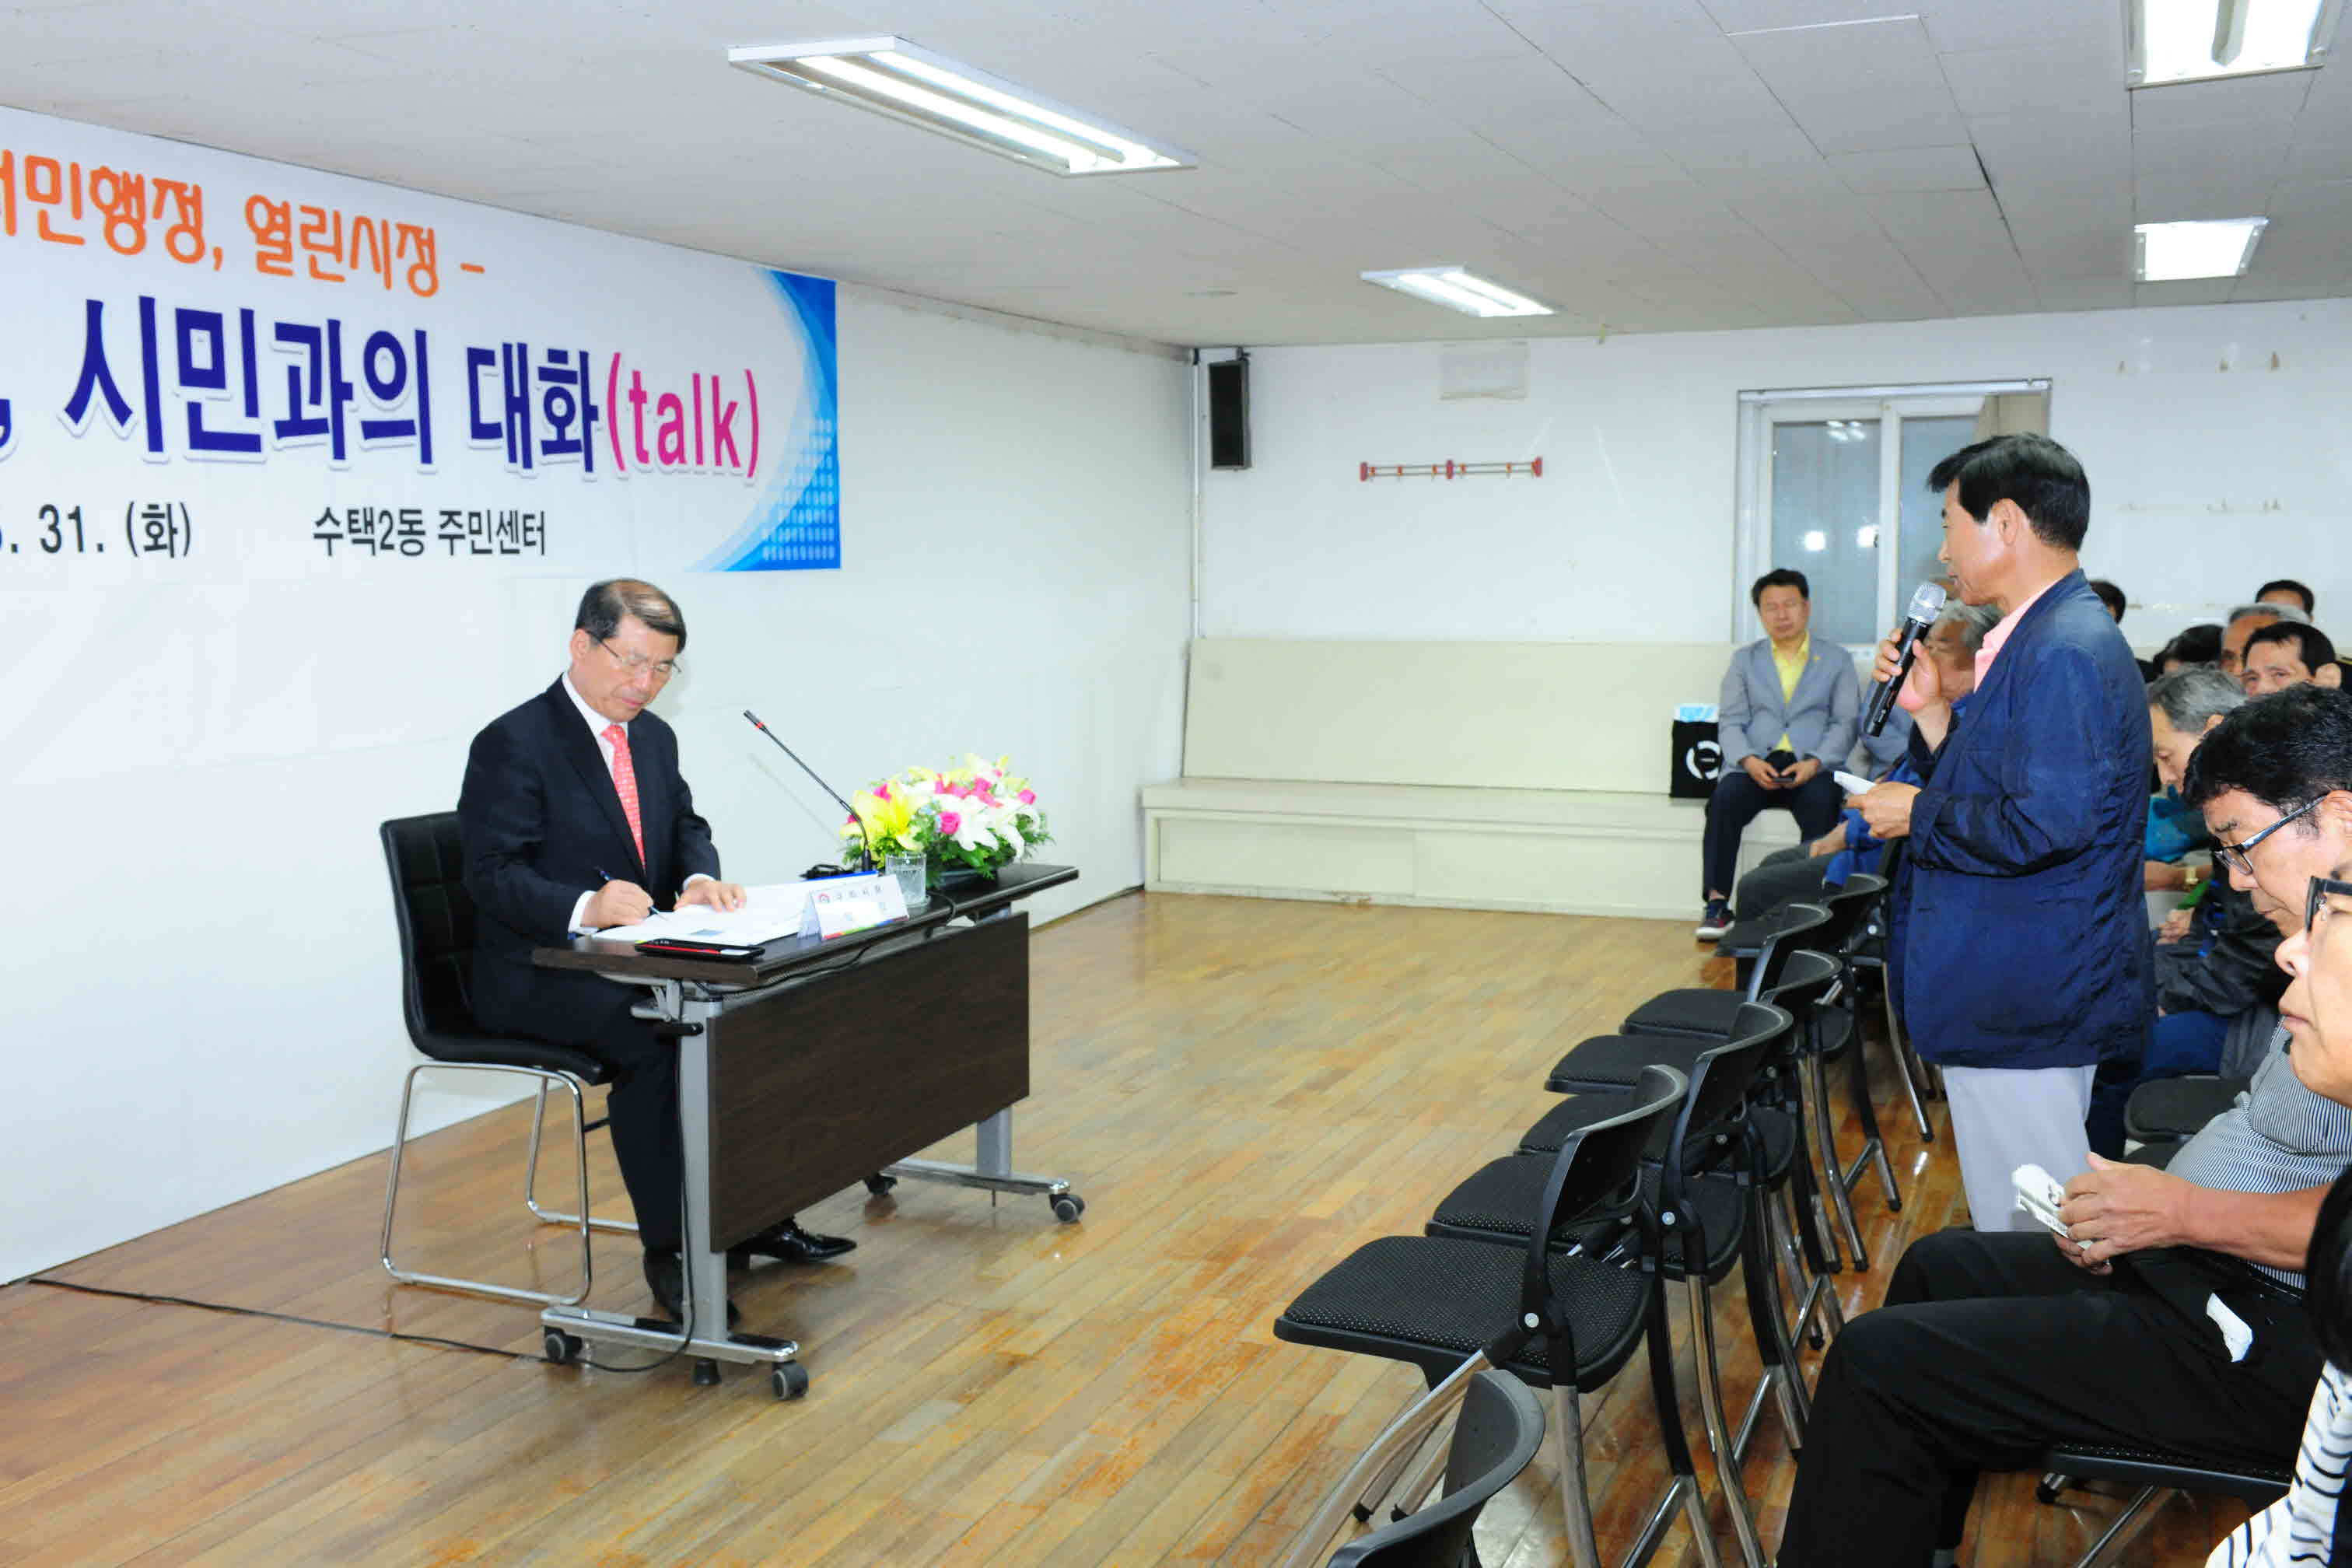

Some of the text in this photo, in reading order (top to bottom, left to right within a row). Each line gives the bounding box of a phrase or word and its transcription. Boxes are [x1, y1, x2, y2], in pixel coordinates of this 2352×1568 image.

[245, 194, 439, 298] 열린시정
[65, 296, 759, 478] 시민과의 대화(talk)
[127, 502, 191, 558] (화)
[313, 507, 545, 557] 수택2동 주민센터
